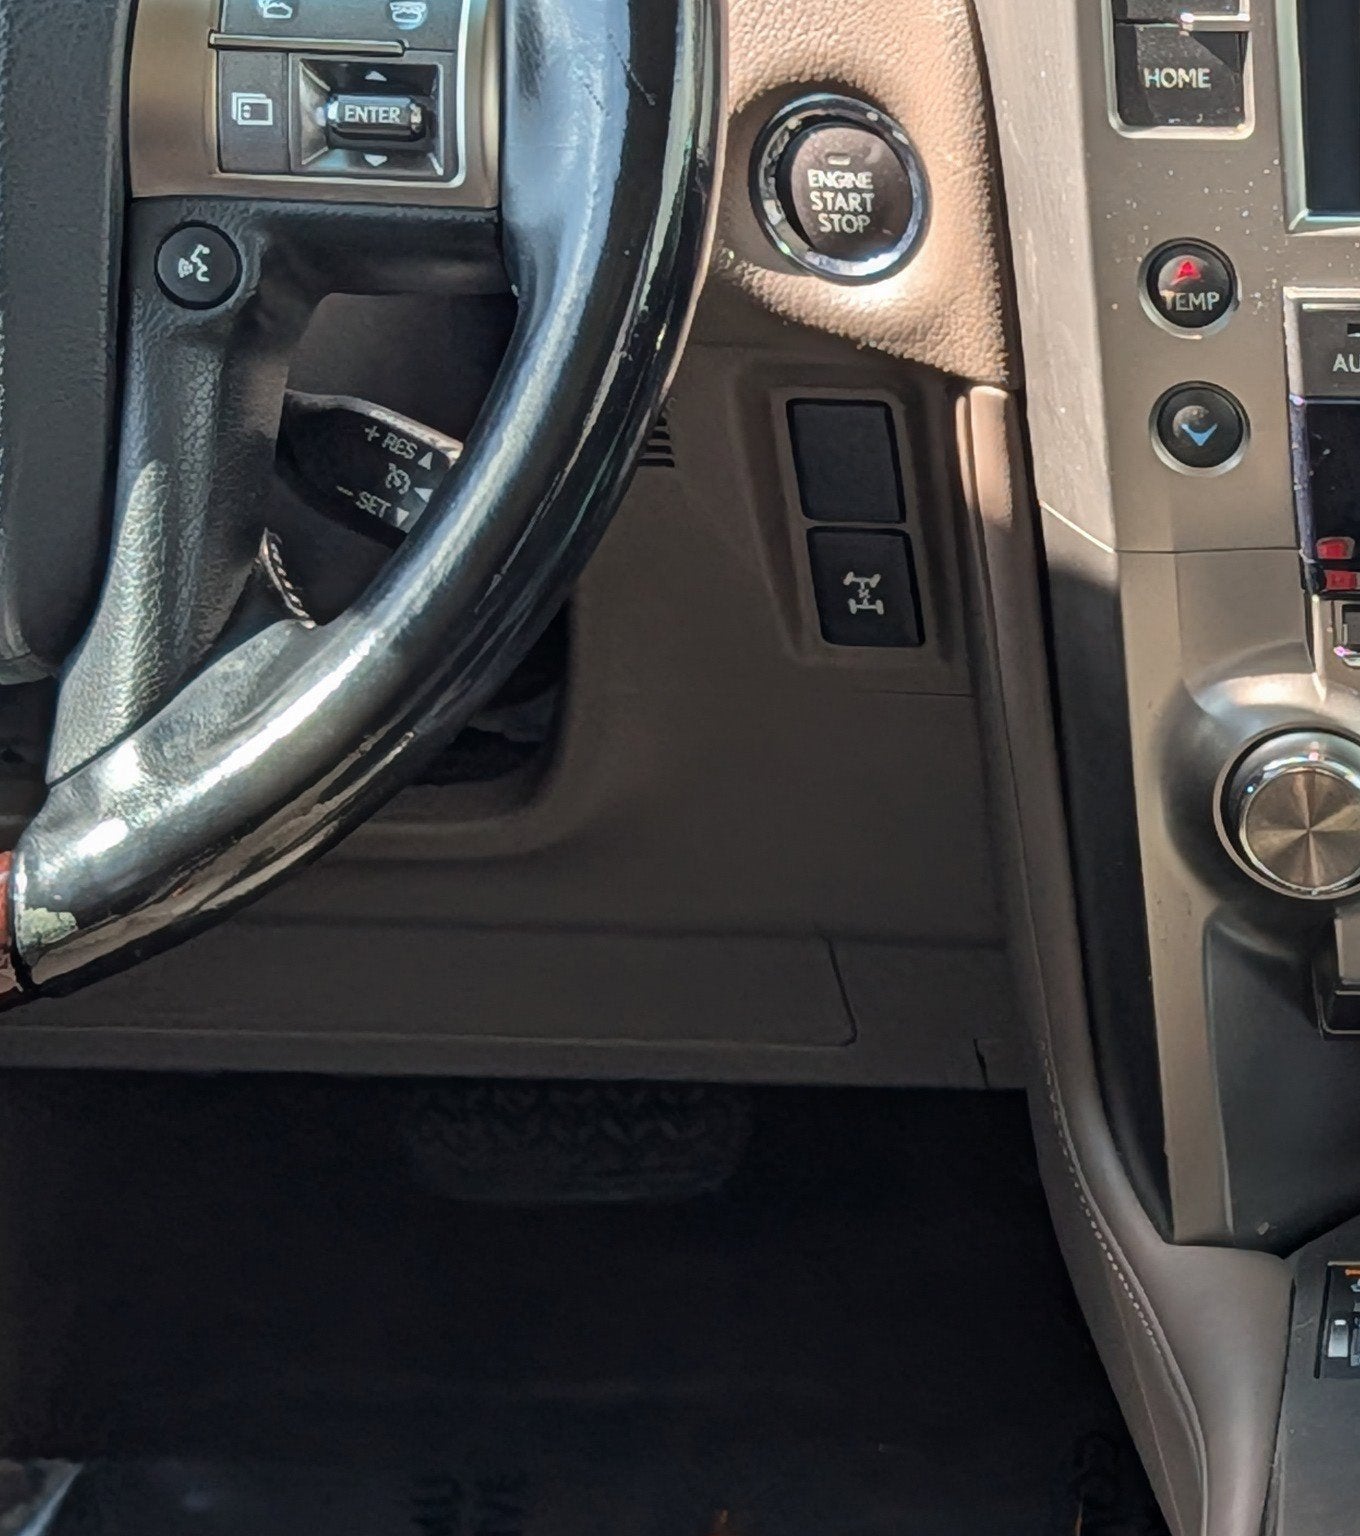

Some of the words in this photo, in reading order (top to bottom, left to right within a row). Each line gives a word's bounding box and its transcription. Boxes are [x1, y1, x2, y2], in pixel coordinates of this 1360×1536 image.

[1144, 67, 1212, 89] HOME
[343, 104, 401, 124] ENTER
[807, 169, 874, 189] ENGINE
[809, 190, 875, 213] START
[818, 212, 871, 233] STOP
[1159, 289, 1221, 312] TEMP
[381, 431, 418, 460] RES
[355, 490, 392, 518] SET
